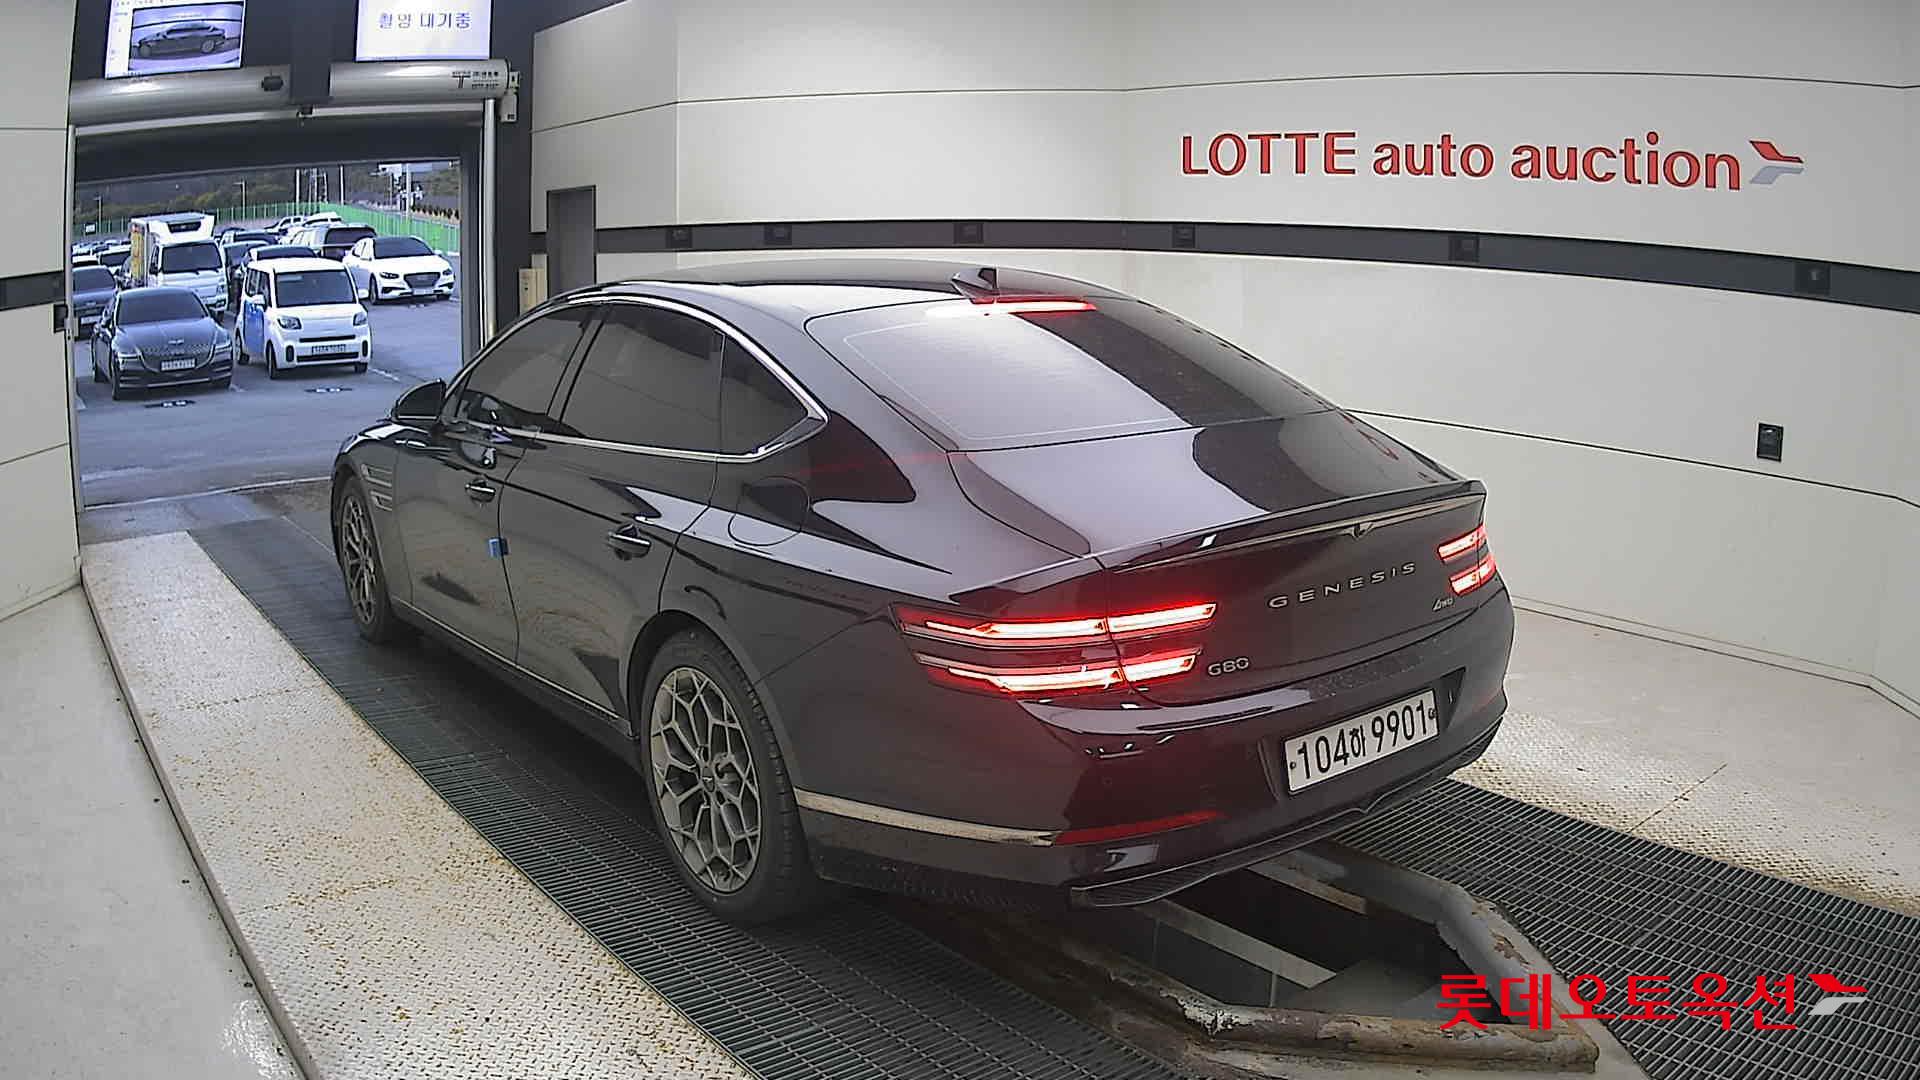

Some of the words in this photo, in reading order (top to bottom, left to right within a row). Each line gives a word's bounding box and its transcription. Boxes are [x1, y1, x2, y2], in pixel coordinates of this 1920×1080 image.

[420, 12, 471, 29] 대기중
[1182, 131, 1357, 175] LOTTE
[1373, 133, 1494, 177] auto
[1511, 130, 1742, 191] auction
[1268, 562, 1417, 609] GENESIS
[1207, 656, 1249, 677] G80
[1297, 728, 1367, 780] 104하
[1371, 699, 1429, 753] 9901
